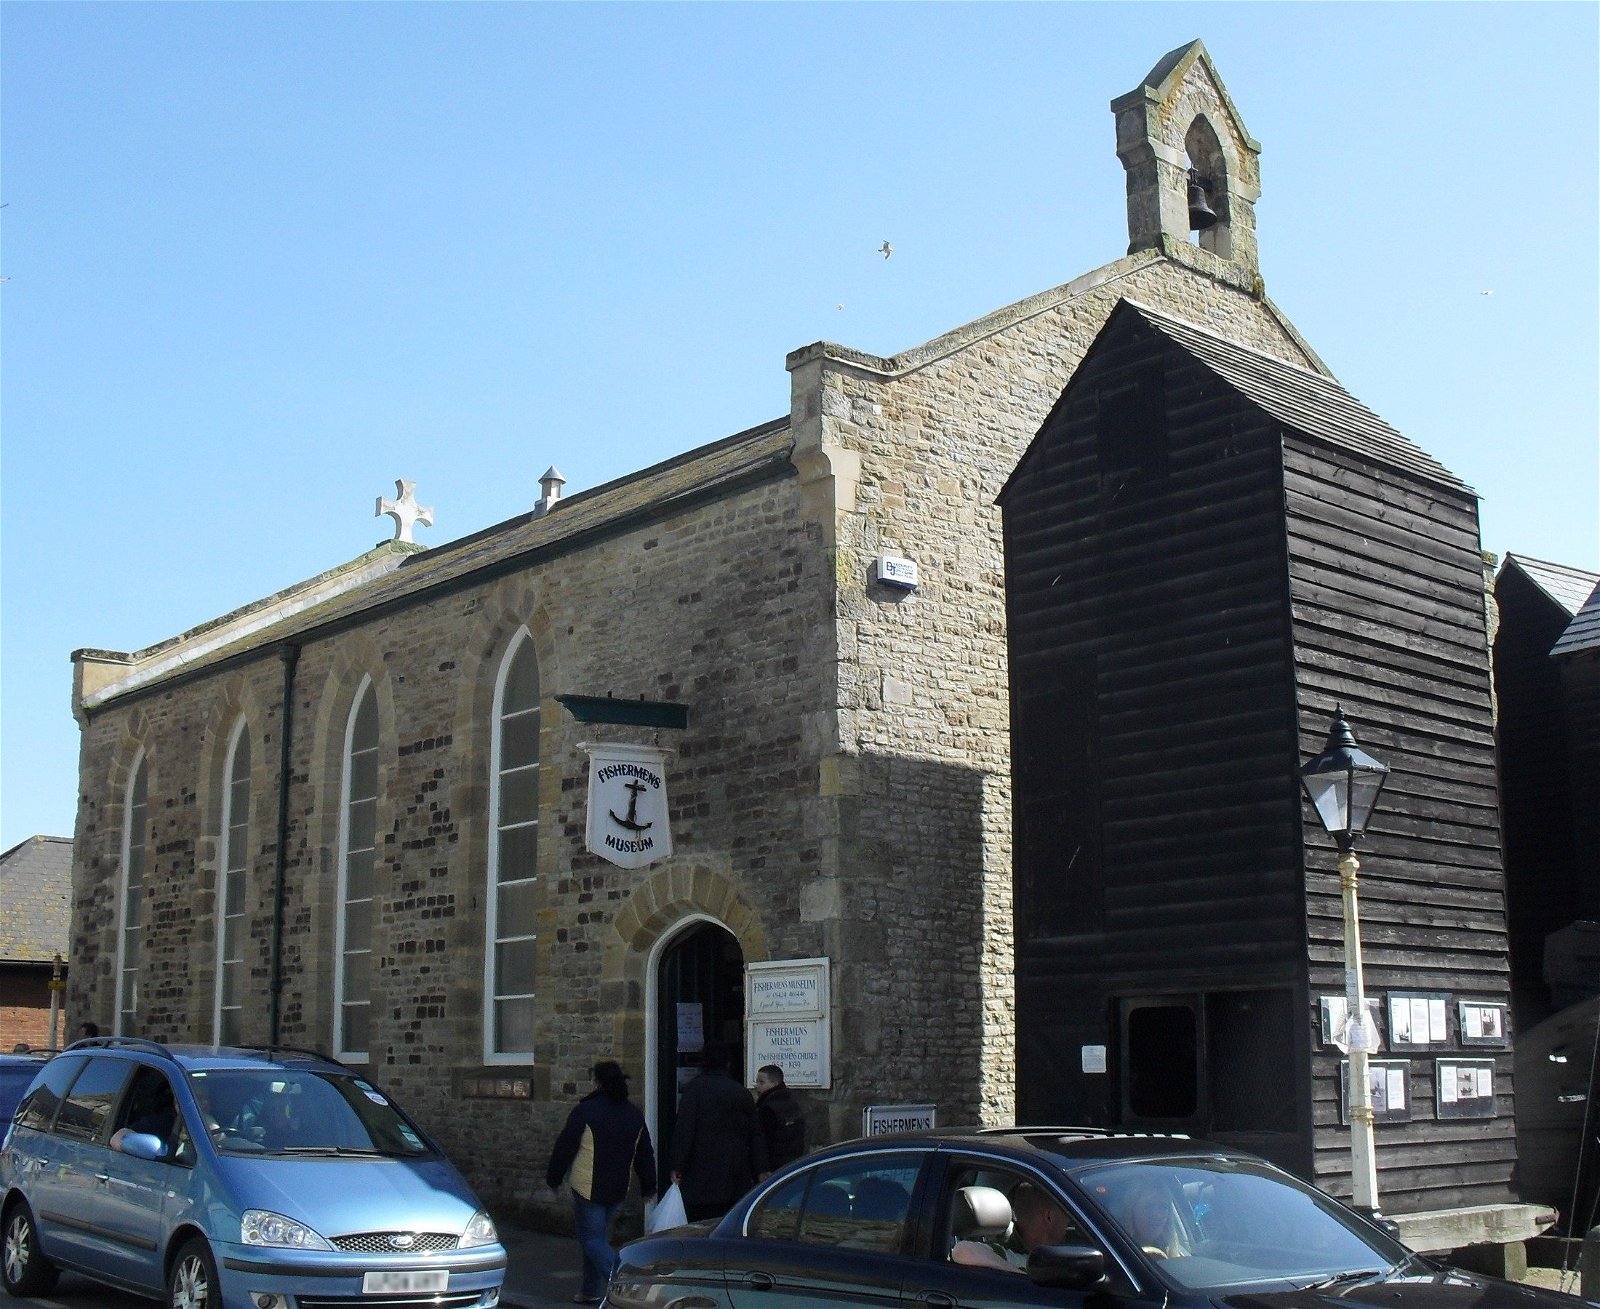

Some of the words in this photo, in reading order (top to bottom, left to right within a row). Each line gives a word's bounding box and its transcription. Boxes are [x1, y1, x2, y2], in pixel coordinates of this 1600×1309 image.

[597, 764, 661, 789] FISHERMENS
[605, 834, 654, 852] MUSEUM
[788, 979, 815, 990] MUSEUM
[771, 1036, 801, 1046] MUSEUM
[874, 1118, 930, 1135] FISHERMEN'S
